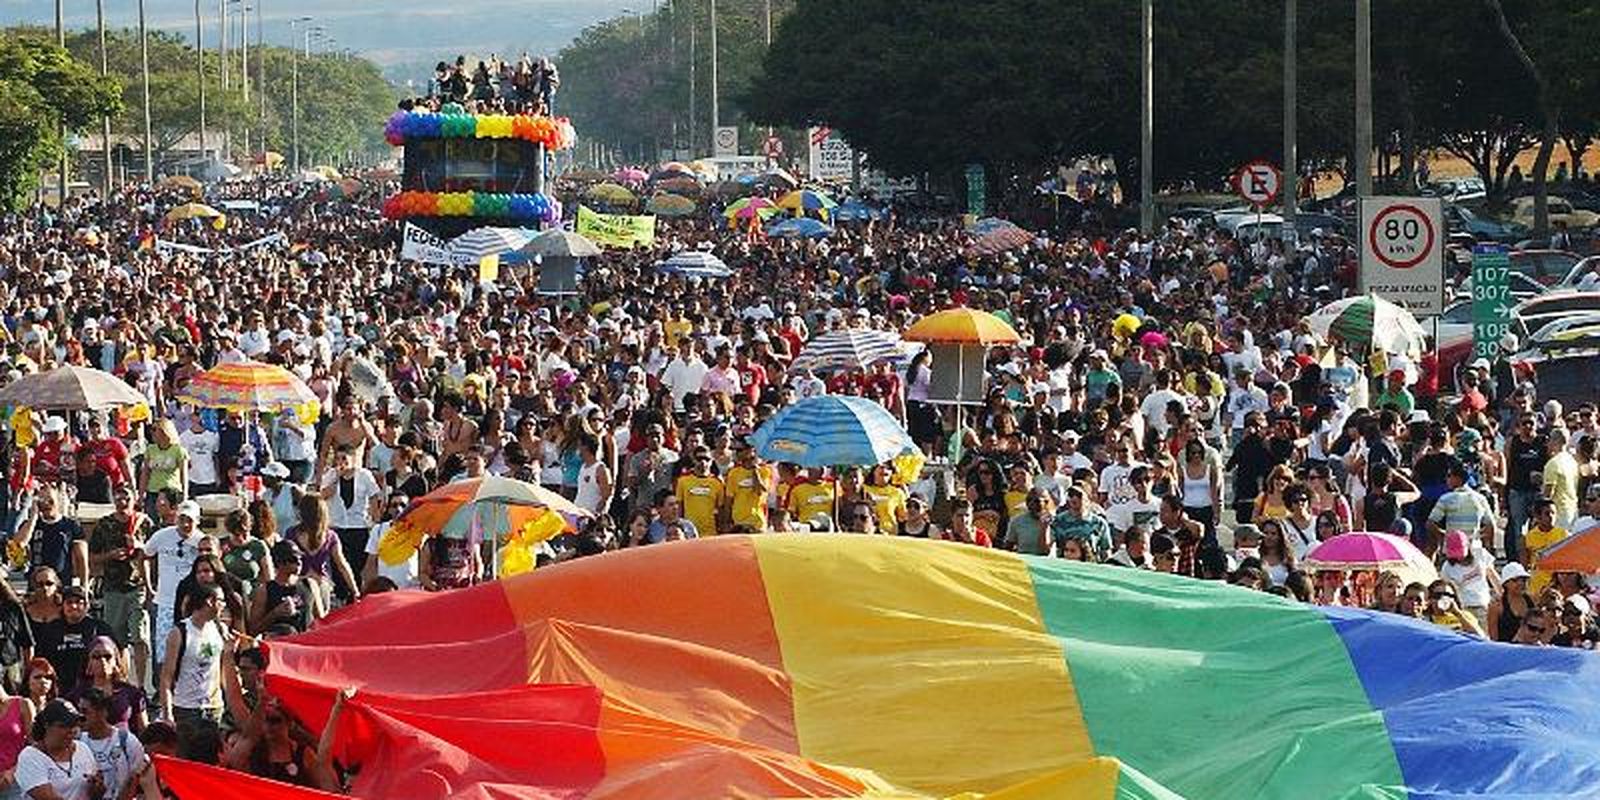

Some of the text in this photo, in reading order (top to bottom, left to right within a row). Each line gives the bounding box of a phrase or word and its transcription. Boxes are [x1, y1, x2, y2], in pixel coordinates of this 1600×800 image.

[1385, 219, 1418, 240] 80
[1476, 267, 1508, 281] 107
[1475, 285, 1508, 300] 307
[1476, 323, 1509, 338] 108
[1476, 341, 1500, 356] 30
